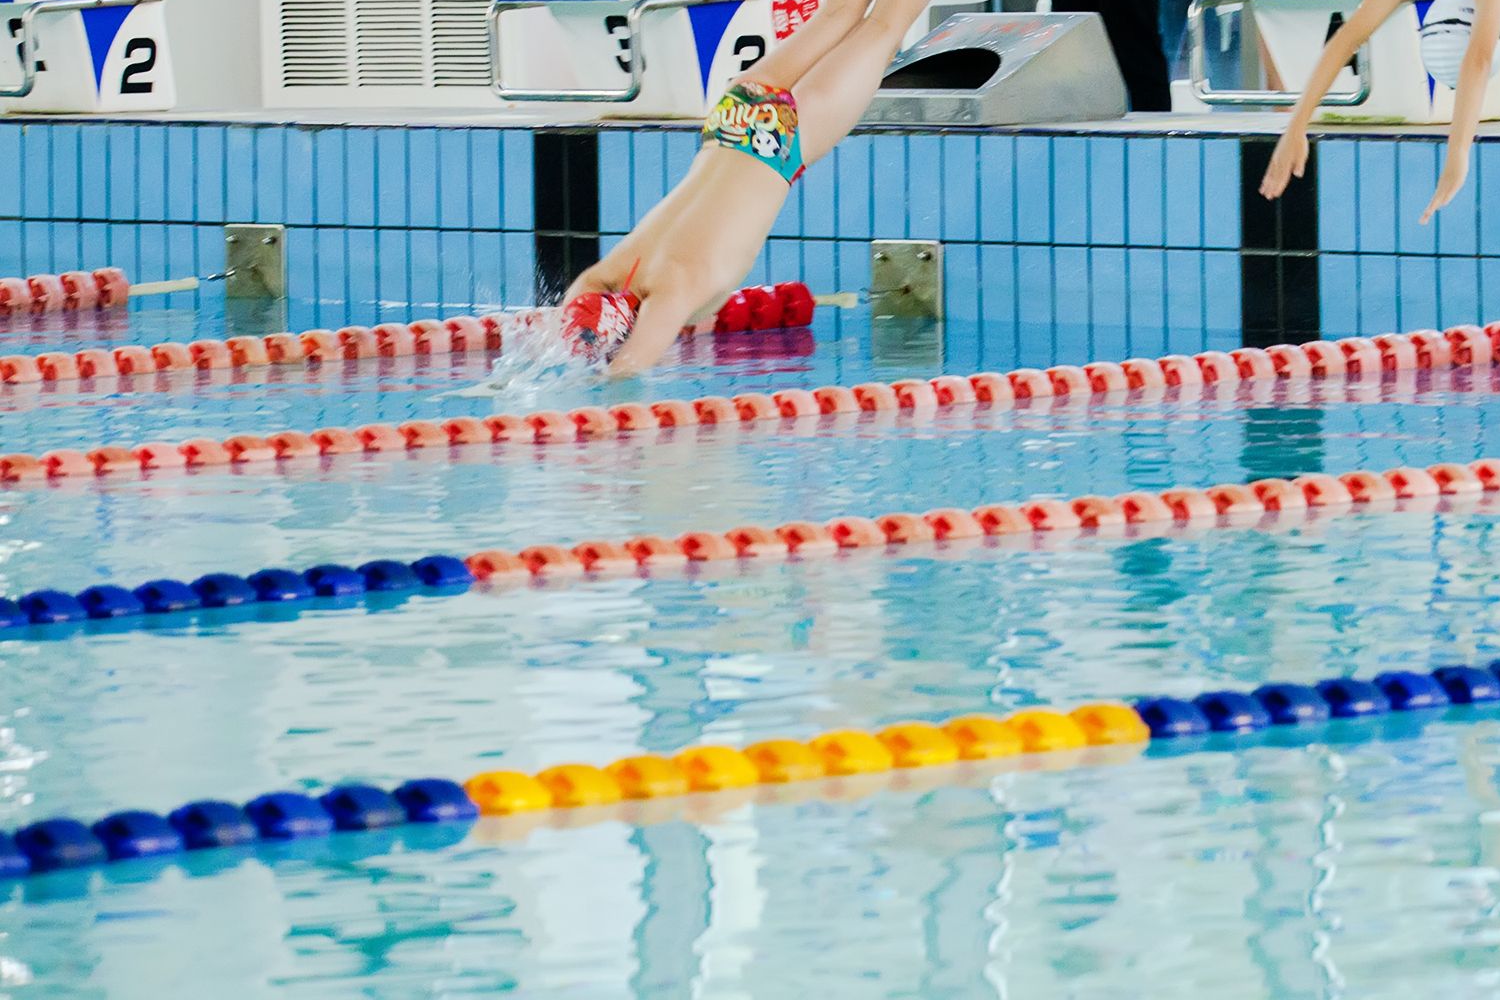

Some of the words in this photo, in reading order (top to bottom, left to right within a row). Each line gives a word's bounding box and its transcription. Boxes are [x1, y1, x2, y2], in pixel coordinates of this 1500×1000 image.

[120, 37, 157, 94] 2
[605, 15, 647, 73] 3
[714, 103, 778, 131] Chin
